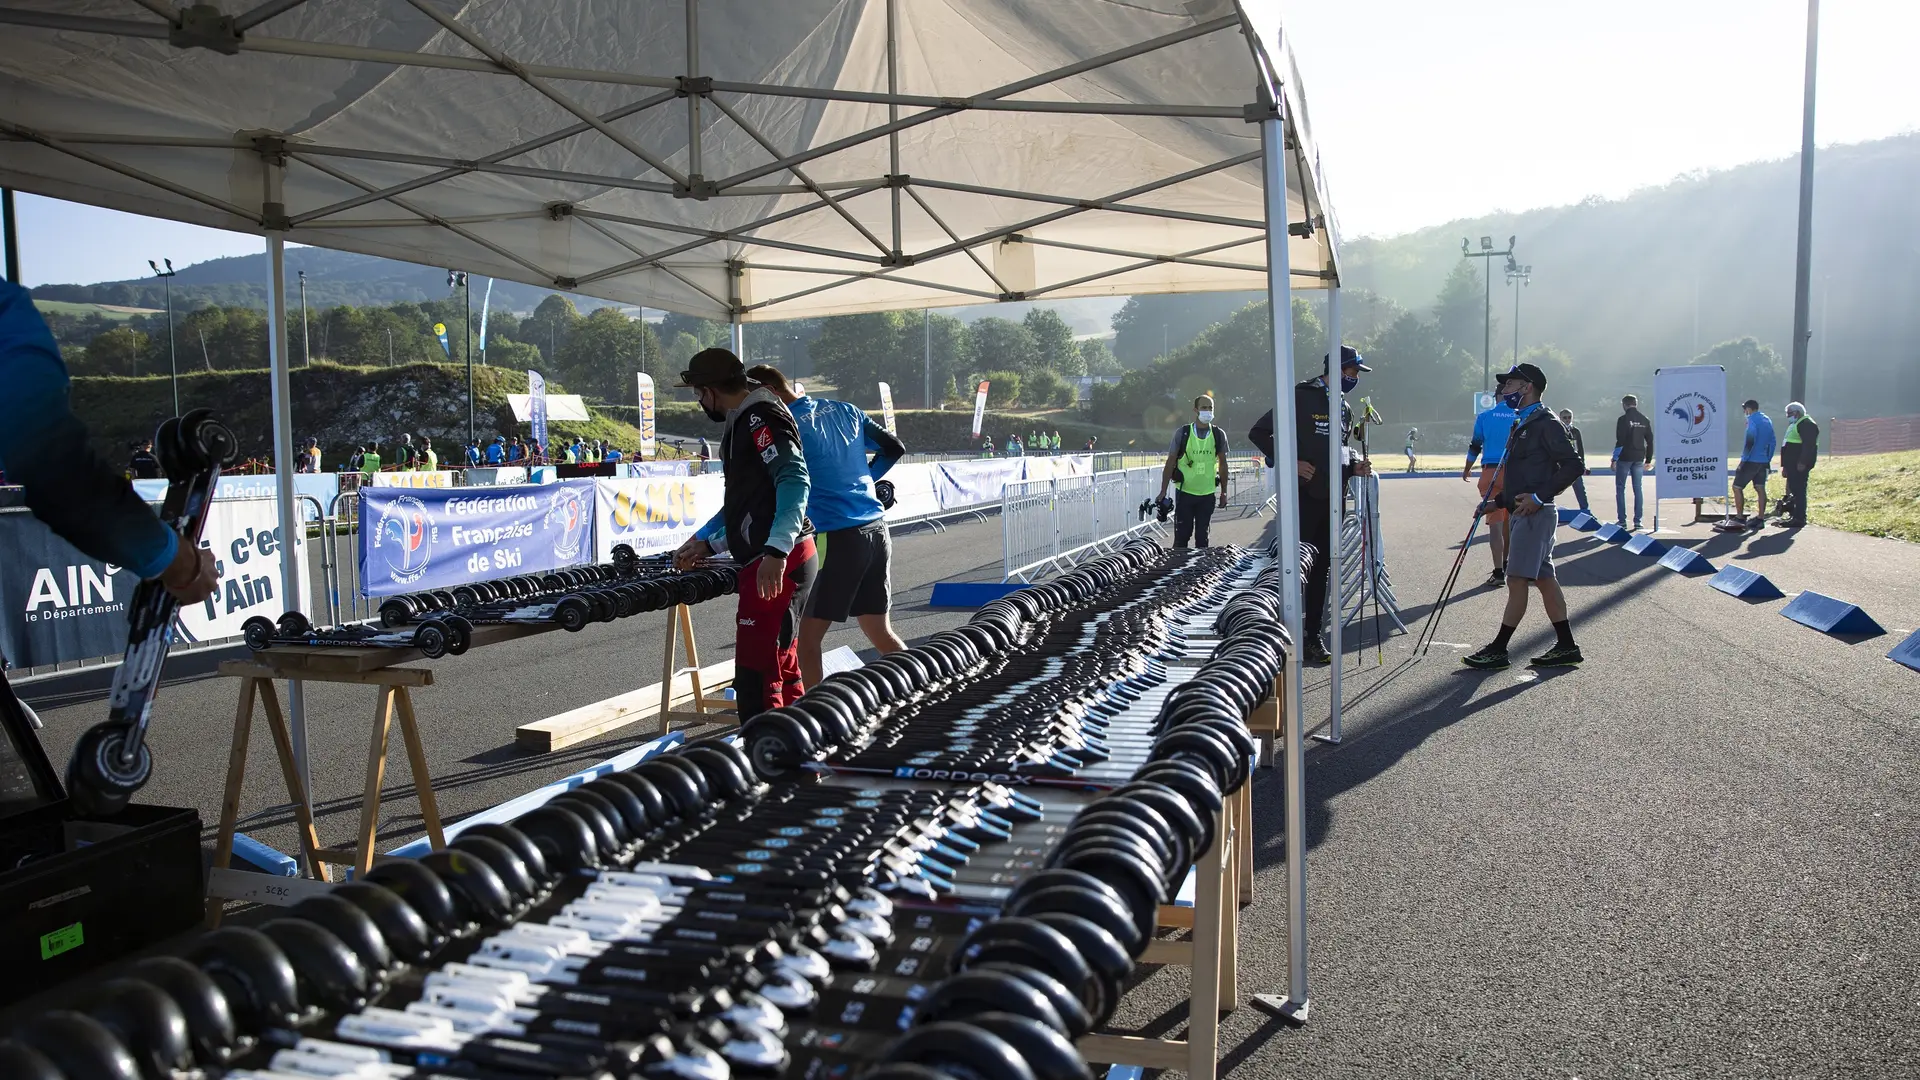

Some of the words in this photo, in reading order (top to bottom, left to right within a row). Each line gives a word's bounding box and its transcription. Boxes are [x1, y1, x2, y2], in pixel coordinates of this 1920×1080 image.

[800, 403, 836, 424] FRANCE
[1664, 456, 1719, 465] Fédération
[1666, 464, 1717, 474] Française
[1675, 473, 1689, 481] de
[1691, 472, 1708, 480] Ski
[445, 495, 538, 517] Fédération
[610, 482, 697, 534] SAMSE
[375, 500, 398, 548] Fédération
[397, 495, 428, 515] Française
[431, 527, 439, 543] Ski
[451, 522, 533, 547] Française
[634, 537, 646, 549] LES
[646, 535, 672, 549] HOMMES
[466, 556, 491, 574] de
[494, 548, 522, 569] Ski
[390, 566, 427, 584] www.ffs.fr
[26, 564, 114, 612] AIN
[25, 613, 37, 622] le
[43, 602, 124, 620] Département
[265, 885, 290, 897] SCBC
